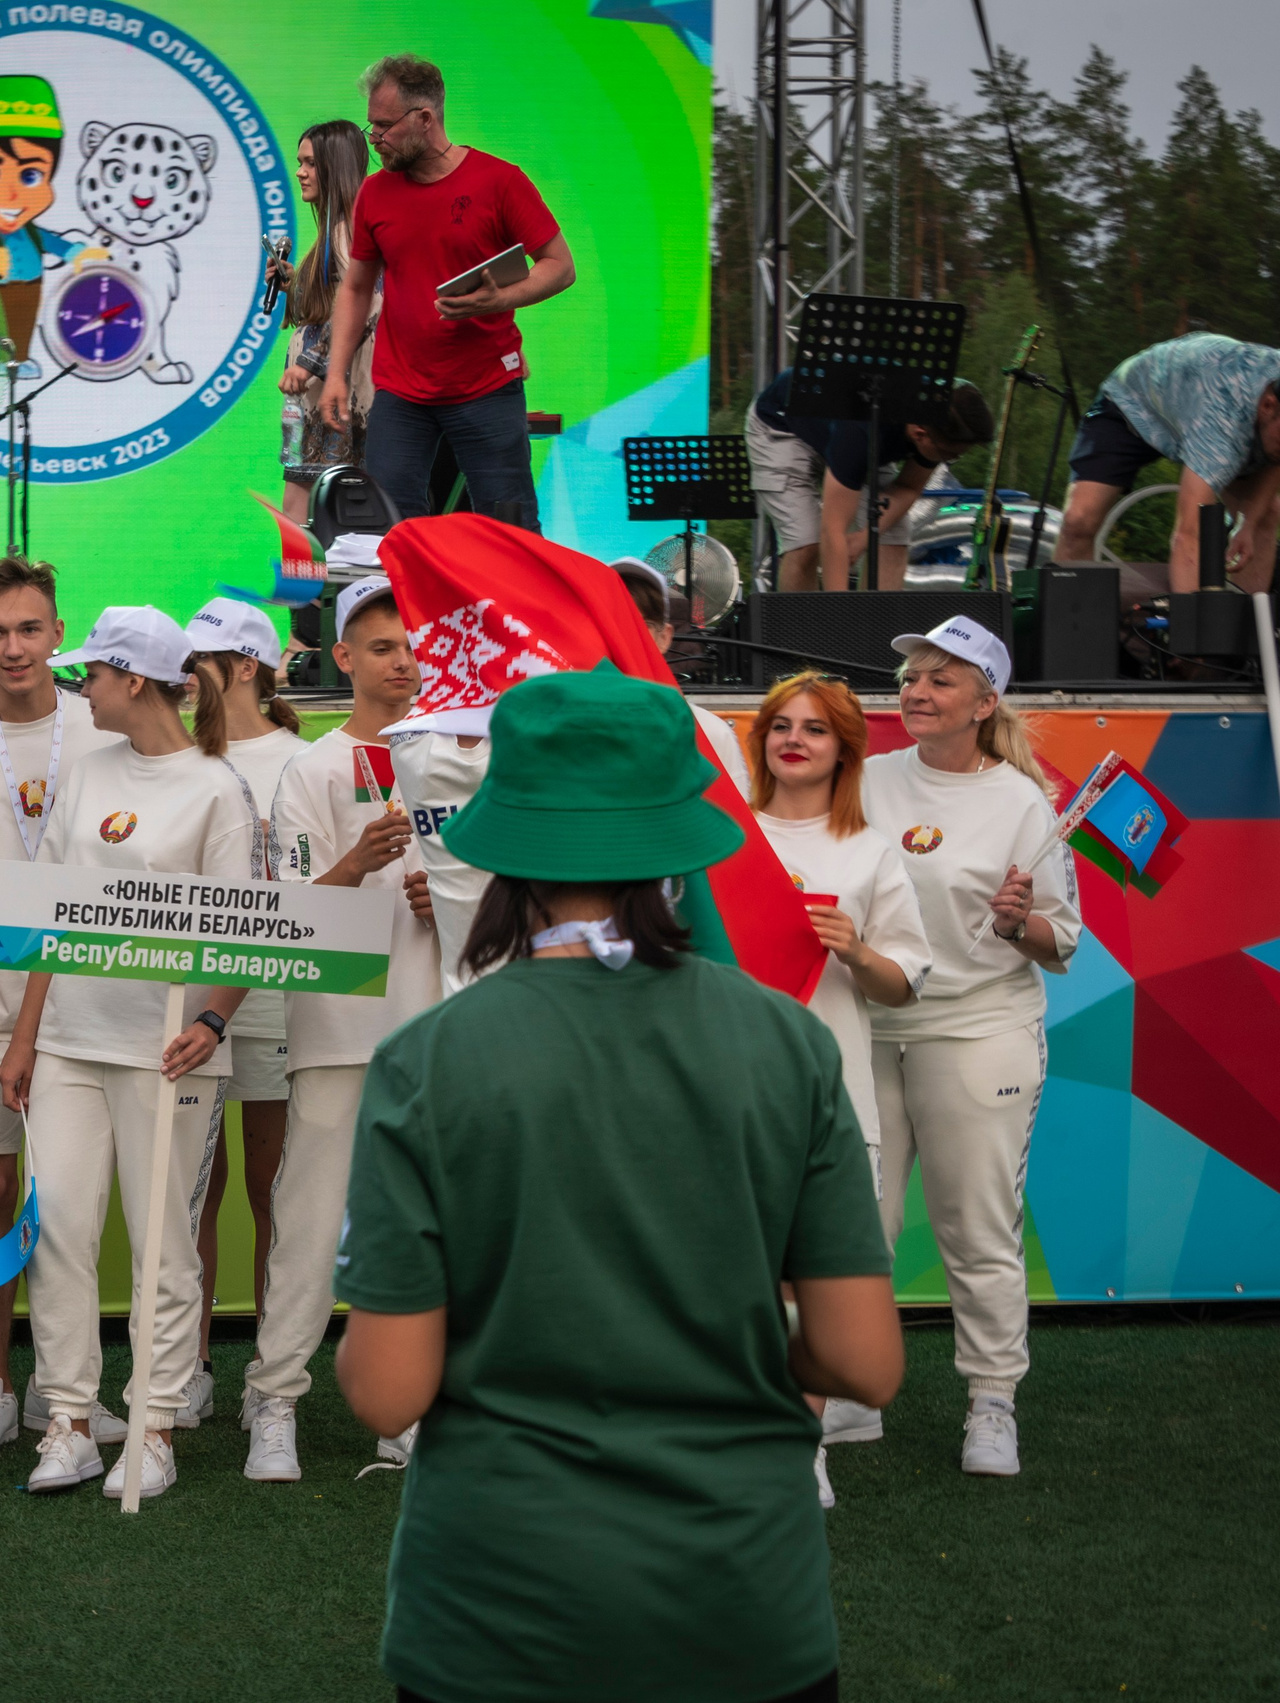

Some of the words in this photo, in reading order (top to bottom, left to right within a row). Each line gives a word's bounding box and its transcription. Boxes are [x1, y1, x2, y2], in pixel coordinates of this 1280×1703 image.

[7, 4, 145, 39] полевая
[148, 30, 276, 172] олимпиада
[199, 284, 279, 407] ологов
[111, 427, 171, 466] 2023
[102, 879, 183, 905] «ЮНЫЕ
[188, 885, 280, 912] ГЕОЛОГИ
[54, 902, 193, 932] РЕСПУБЛИКИ
[199, 913, 315, 940] БЕЛАРУСЬ»
[41, 934, 194, 971] Республика
[201, 947, 321, 984] Беларусь
